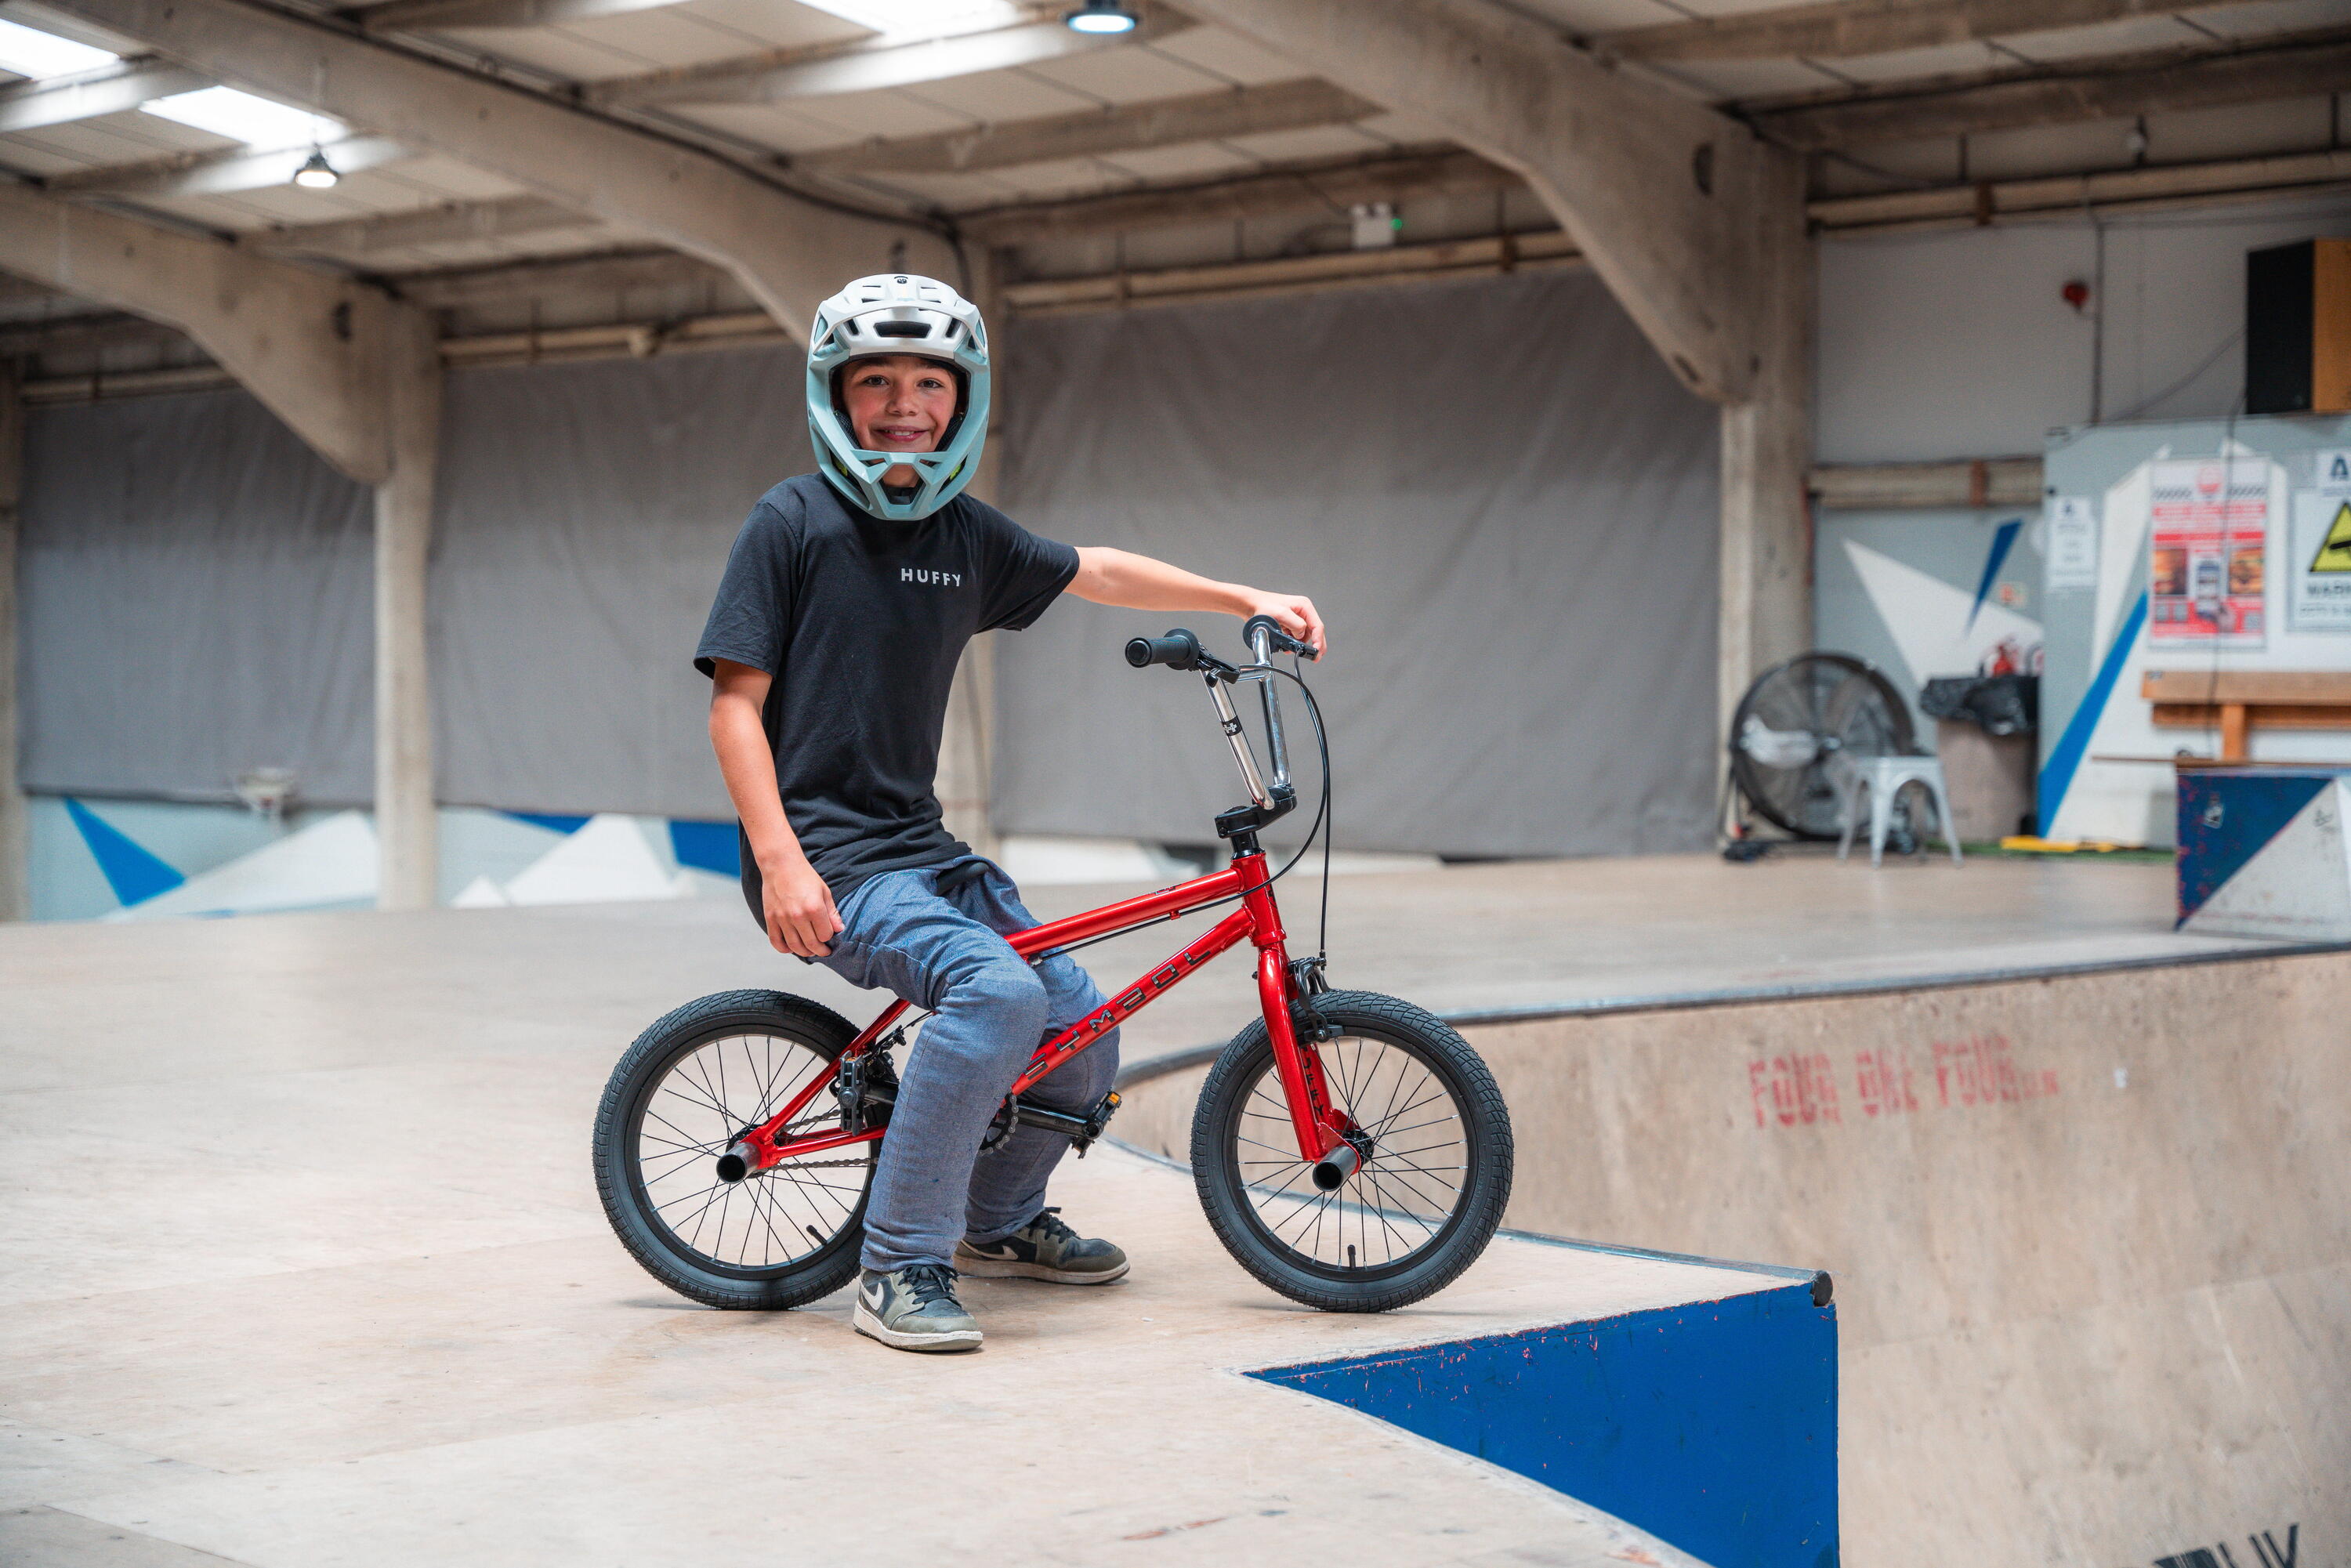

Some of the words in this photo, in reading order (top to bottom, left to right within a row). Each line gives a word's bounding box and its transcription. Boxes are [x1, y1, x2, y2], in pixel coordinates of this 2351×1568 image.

[900, 568, 961, 587] HUFFY
[1024, 951, 1212, 1081] SYMBOL
[1300, 1046, 1324, 1117] UFFY
[1748, 1050, 1842, 1128] FOUR
